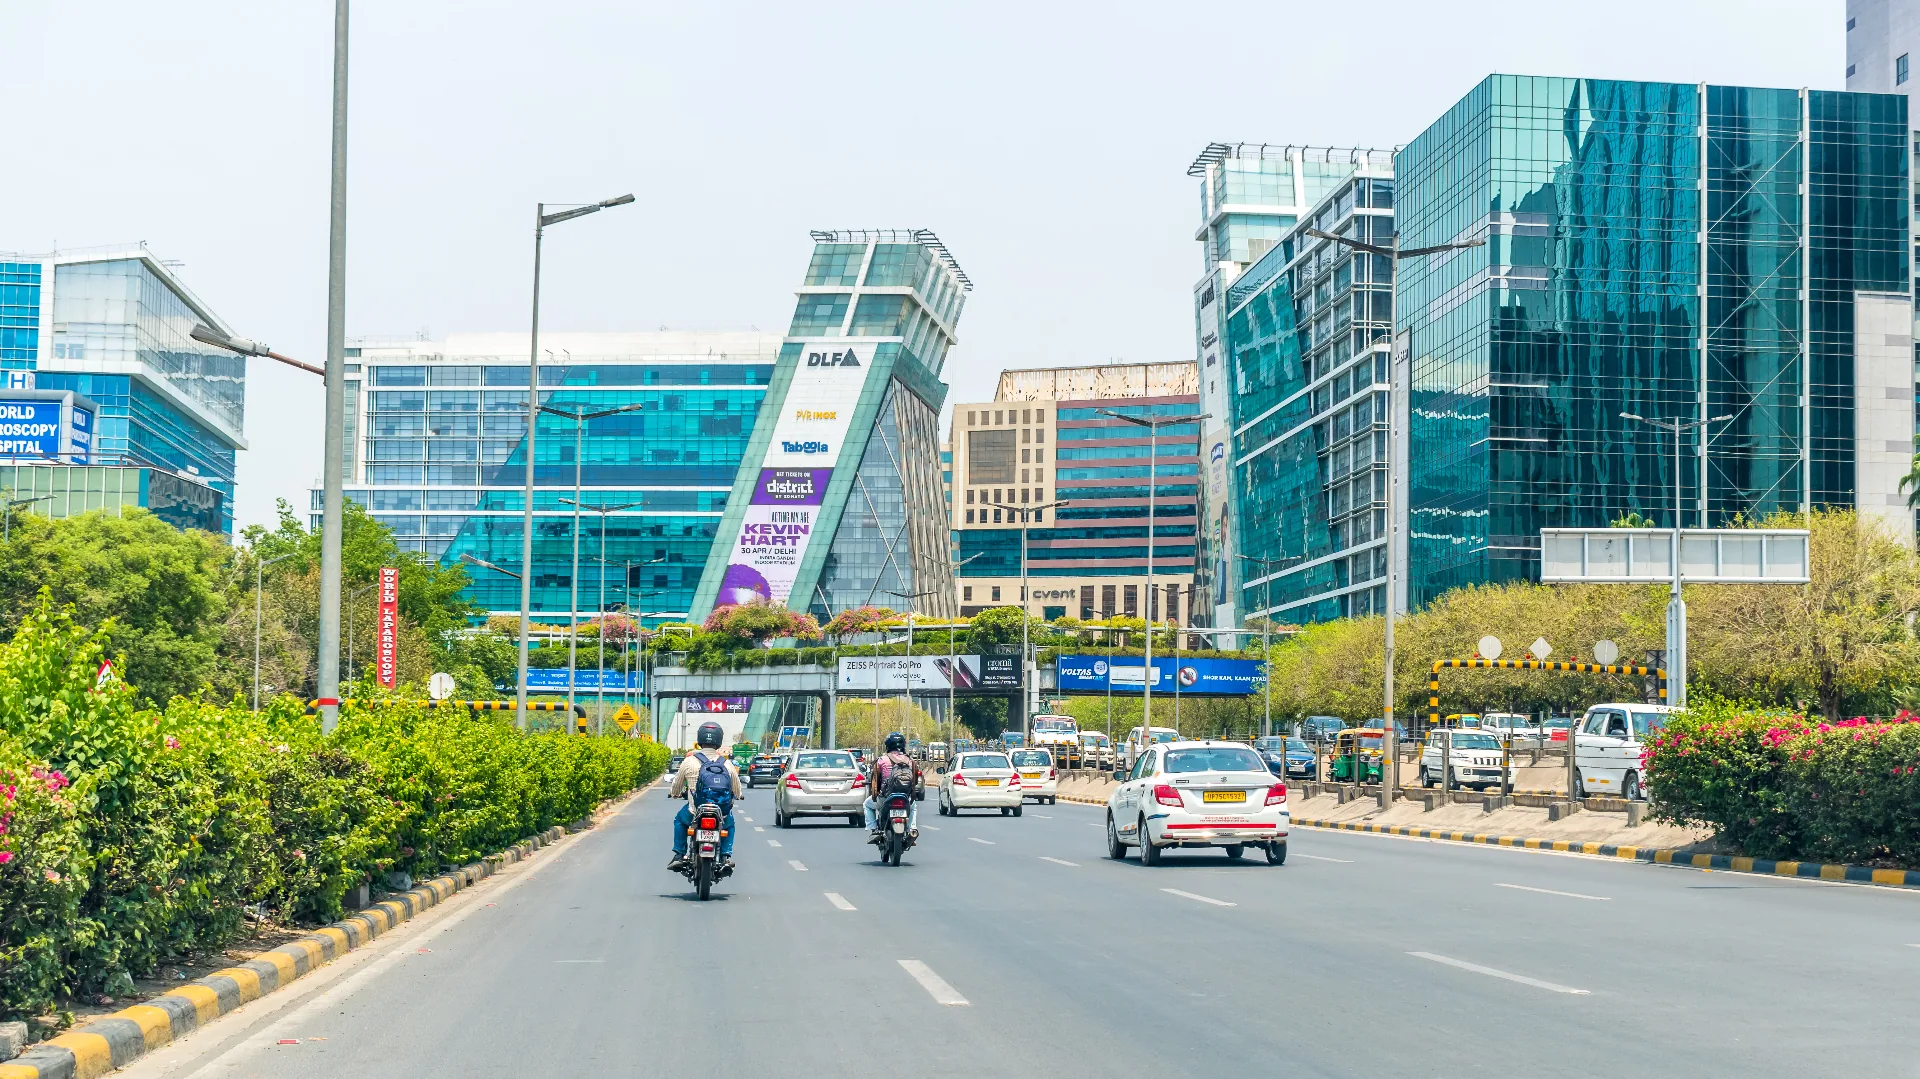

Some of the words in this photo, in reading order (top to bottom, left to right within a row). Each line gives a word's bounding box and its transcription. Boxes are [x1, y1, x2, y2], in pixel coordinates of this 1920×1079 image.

[807, 352, 842, 367] DLF
[11, 373, 25, 389] H
[0, 405, 35, 420] ORLD
[795, 410, 812, 421] PVR
[813, 411, 837, 420] INOX
[781, 441, 829, 454] Taboola
[766, 479, 814, 494] district
[744, 523, 809, 535] KEVIN
[740, 535, 801, 546] HART
[382, 569, 397, 603] WORLD
[1032, 588, 1076, 599] cvent
[382, 608, 394, 683] LAPAROSCOPY
[846, 661, 867, 670] ZEISS
[868, 661, 897, 670] Portrait
[898, 660, 907, 670] So
[909, 660, 922, 669] Pro
[1061, 667, 1092, 676] VOLTAS
